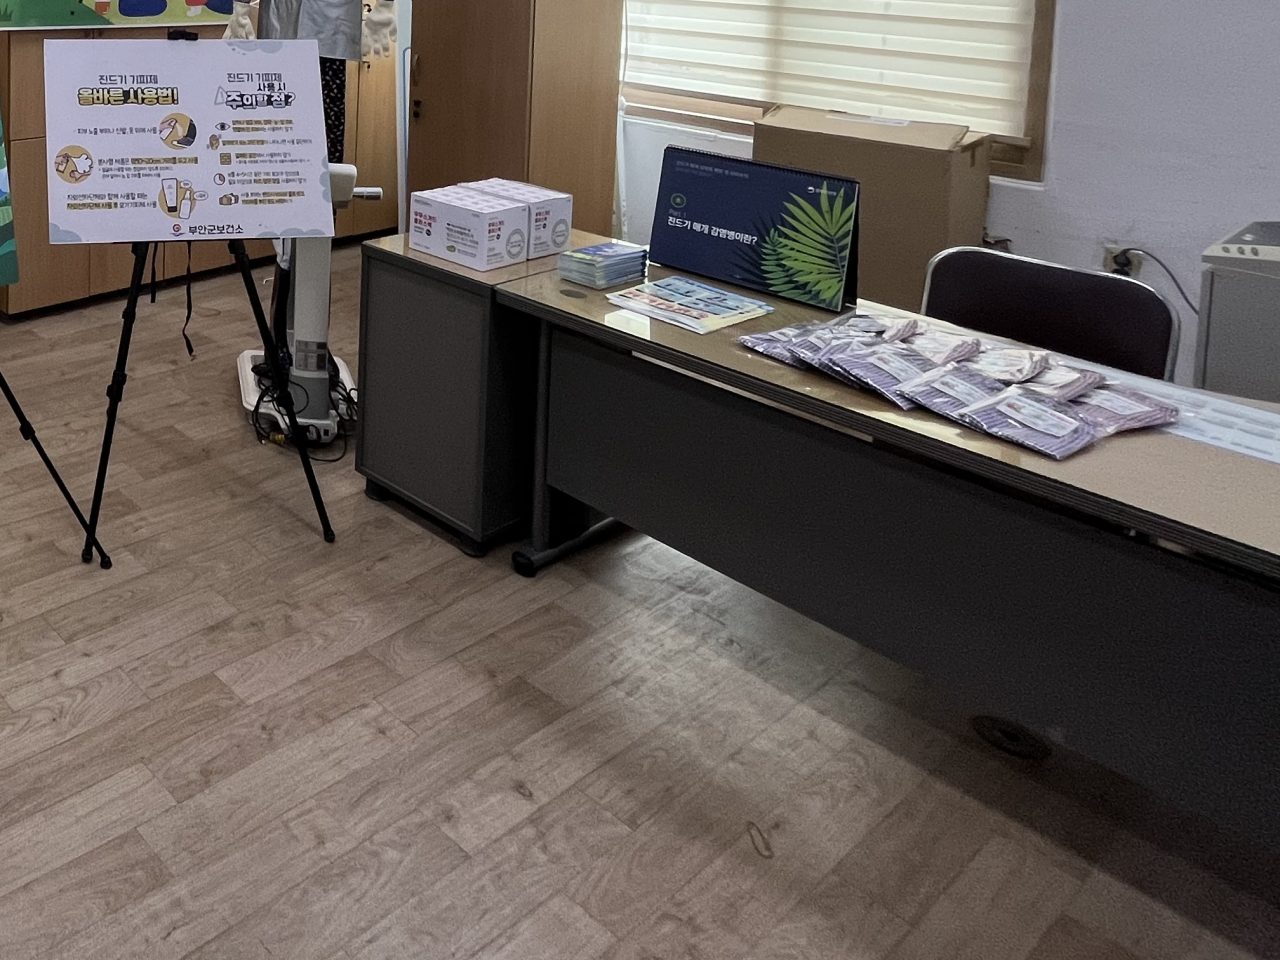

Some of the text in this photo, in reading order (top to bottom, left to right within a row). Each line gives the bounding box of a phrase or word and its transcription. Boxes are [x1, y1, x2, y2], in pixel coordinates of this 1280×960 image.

[99, 74, 158, 85] 진드기 기피제
[227, 73, 282, 82] 진드기 기피제
[278, 82, 285, 91] 시
[78, 87, 179, 105] 올바른 사용법!
[188, 224, 244, 235] 부안군보건소
[668, 216, 691, 230] 진드기
[693, 222, 709, 234] 매개
